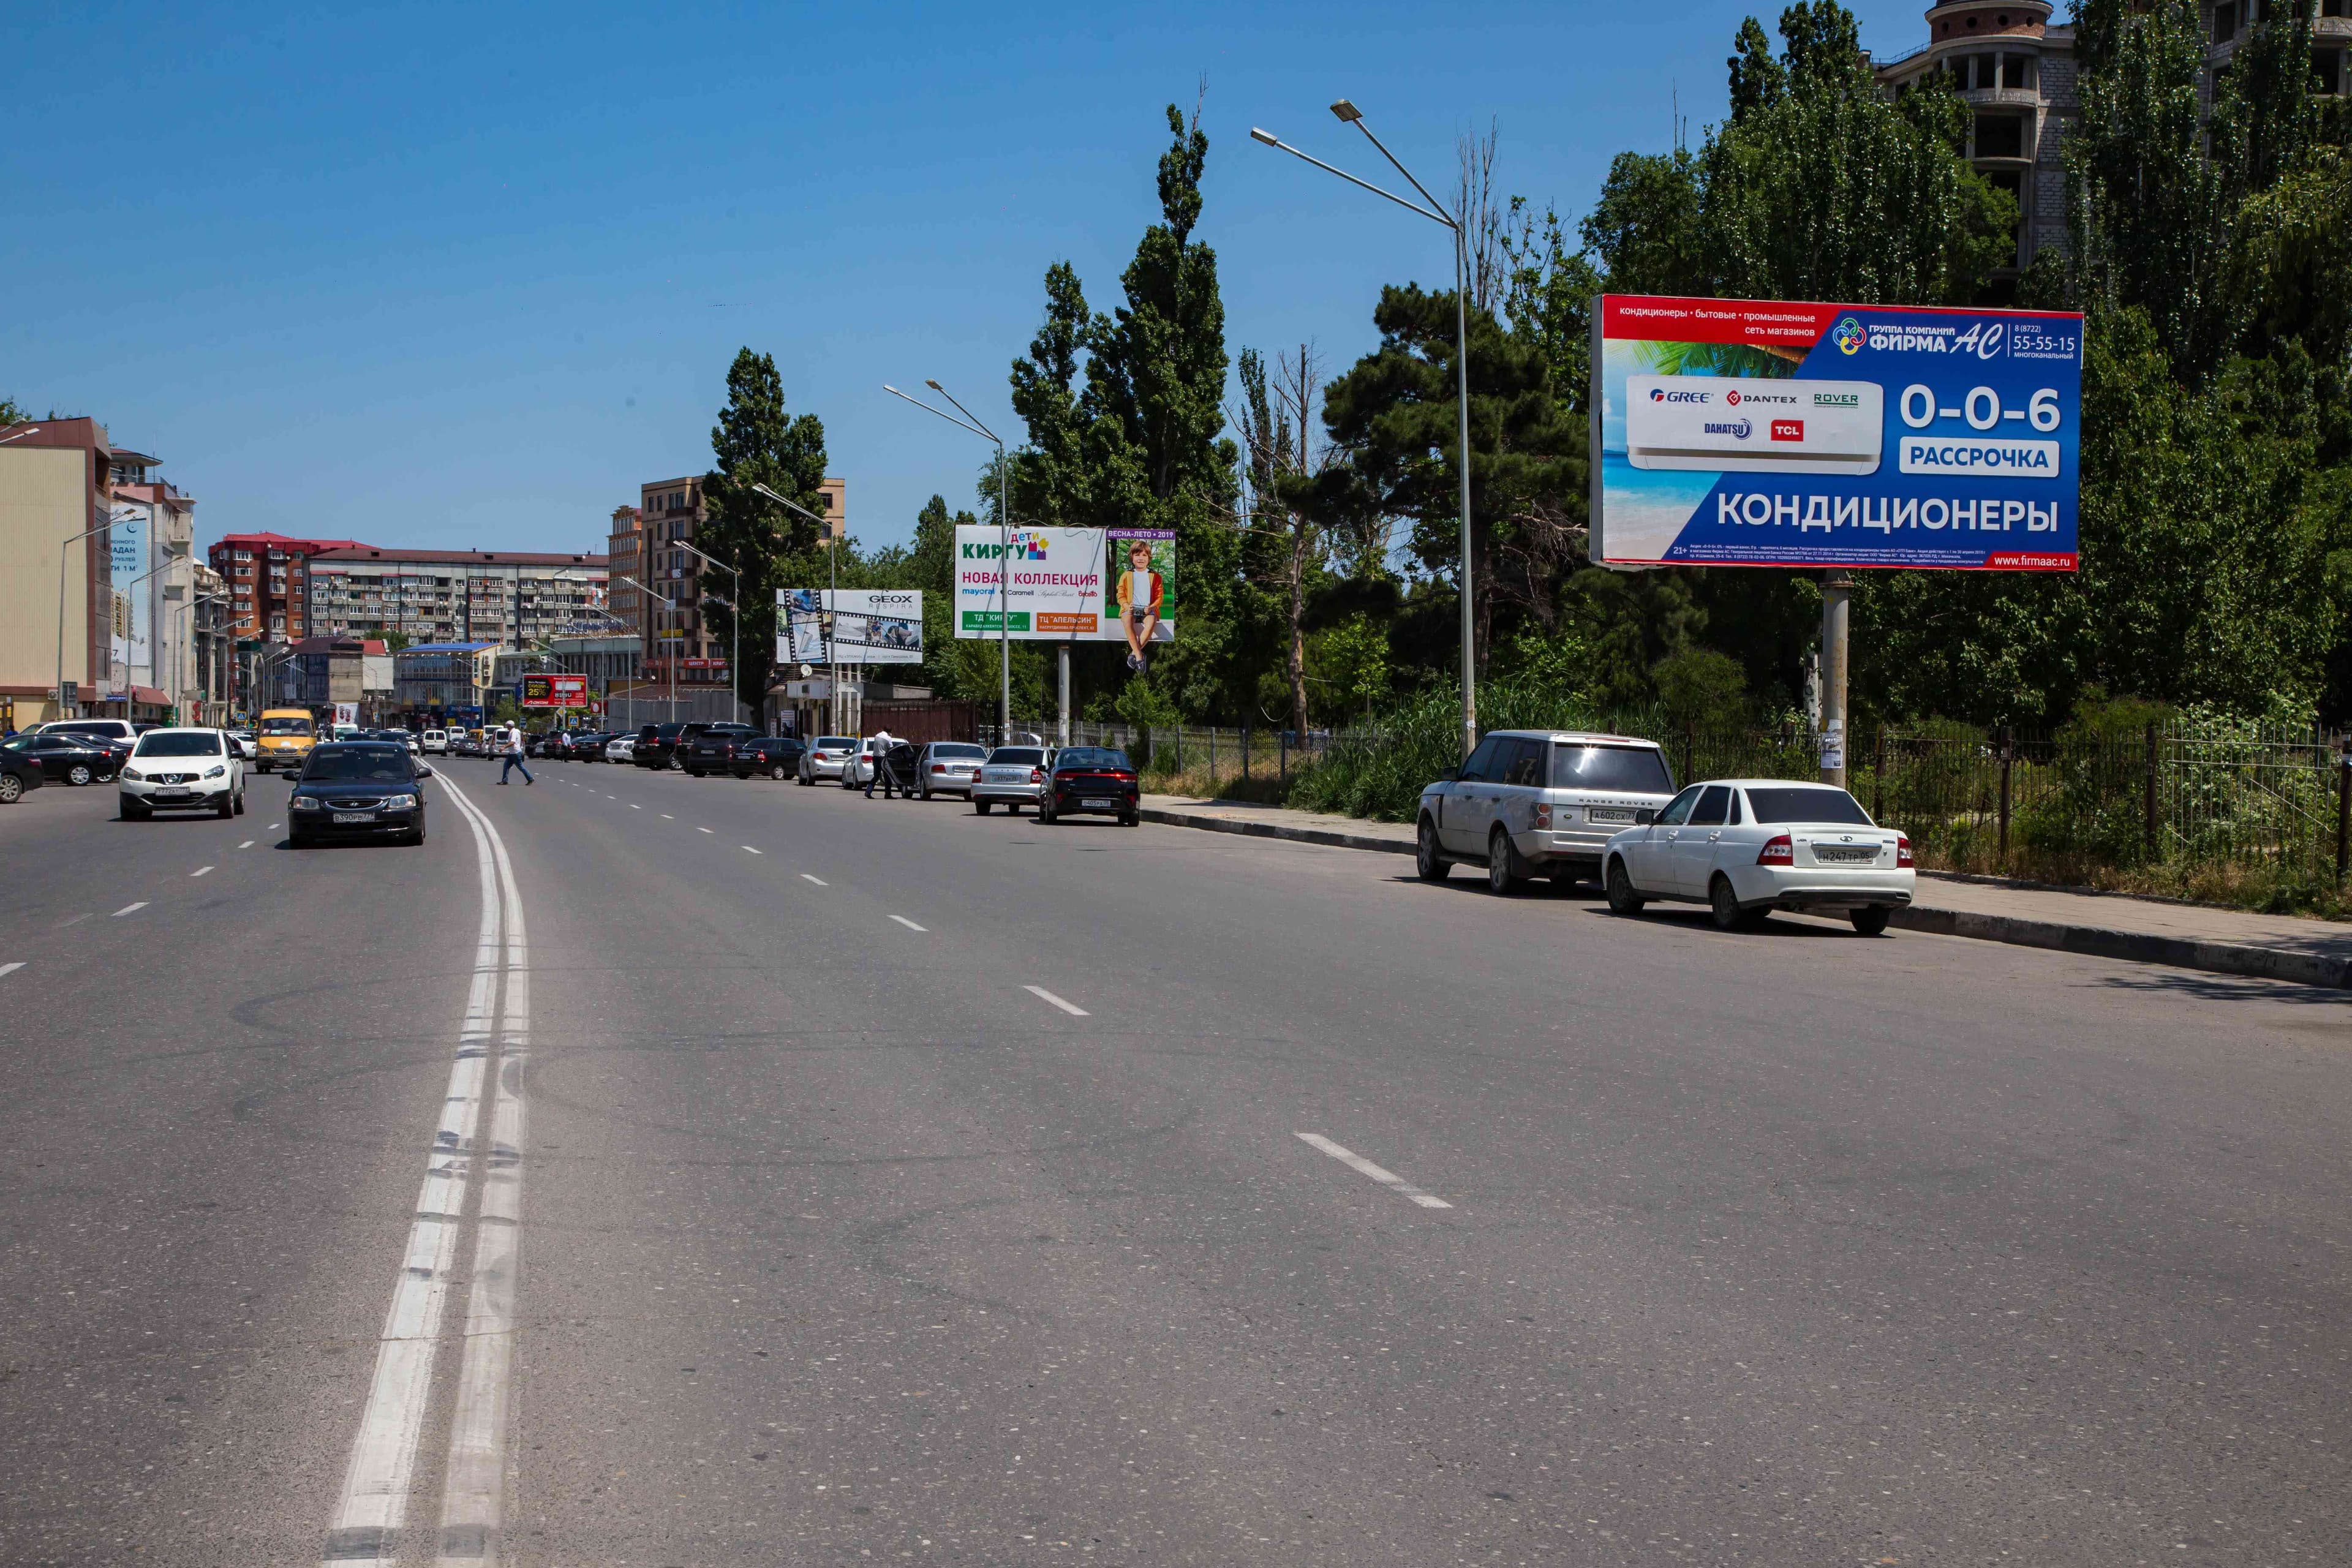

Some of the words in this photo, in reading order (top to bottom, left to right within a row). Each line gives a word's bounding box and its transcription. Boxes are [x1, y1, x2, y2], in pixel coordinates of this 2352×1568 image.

[1619, 307, 1687, 318] кондиционеры
[1695, 308, 1736, 320] бытовые
[1744, 312, 1815, 323] промышленные
[1745, 326, 1765, 336] сеть
[1767, 328, 1815, 336] магазинов
[1869, 325, 1903, 334] ГРУППА
[1905, 326, 1955, 335] КОМПАНИЙ
[2021, 325, 2041, 334] (8722)
[1869, 334, 1947, 352] ФИРМА
[1949, 323, 2004, 360] АС
[2013, 336, 2075, 351] 55-55-15
[2013, 351, 2074, 360] многоканальный
[1667, 391, 1710, 404] GREE
[1744, 395, 1798, 404] DANTEX
[1814, 394, 1858, 402] ROVER
[1900, 383, 2060, 432] 0-0-6
[1705, 423, 1744, 435] DAHATSU
[1775, 426, 1800, 435] TCL
[1910, 446, 2049, 468] РАССРОЧКА
[1717, 492, 2058, 534] КОНДИЦИОНЕРЫ
[1011, 532, 1039, 543] дети
[962, 543, 1027, 559] КИРГУ
[1994, 555, 2070, 567] www.firmaac.ru
[1014, 573, 1098, 588] КОЛЛЕКЦИЯ
[1594, 812, 1626, 820] А602СХ
[1823, 851, 1859, 862] Н247ТР
